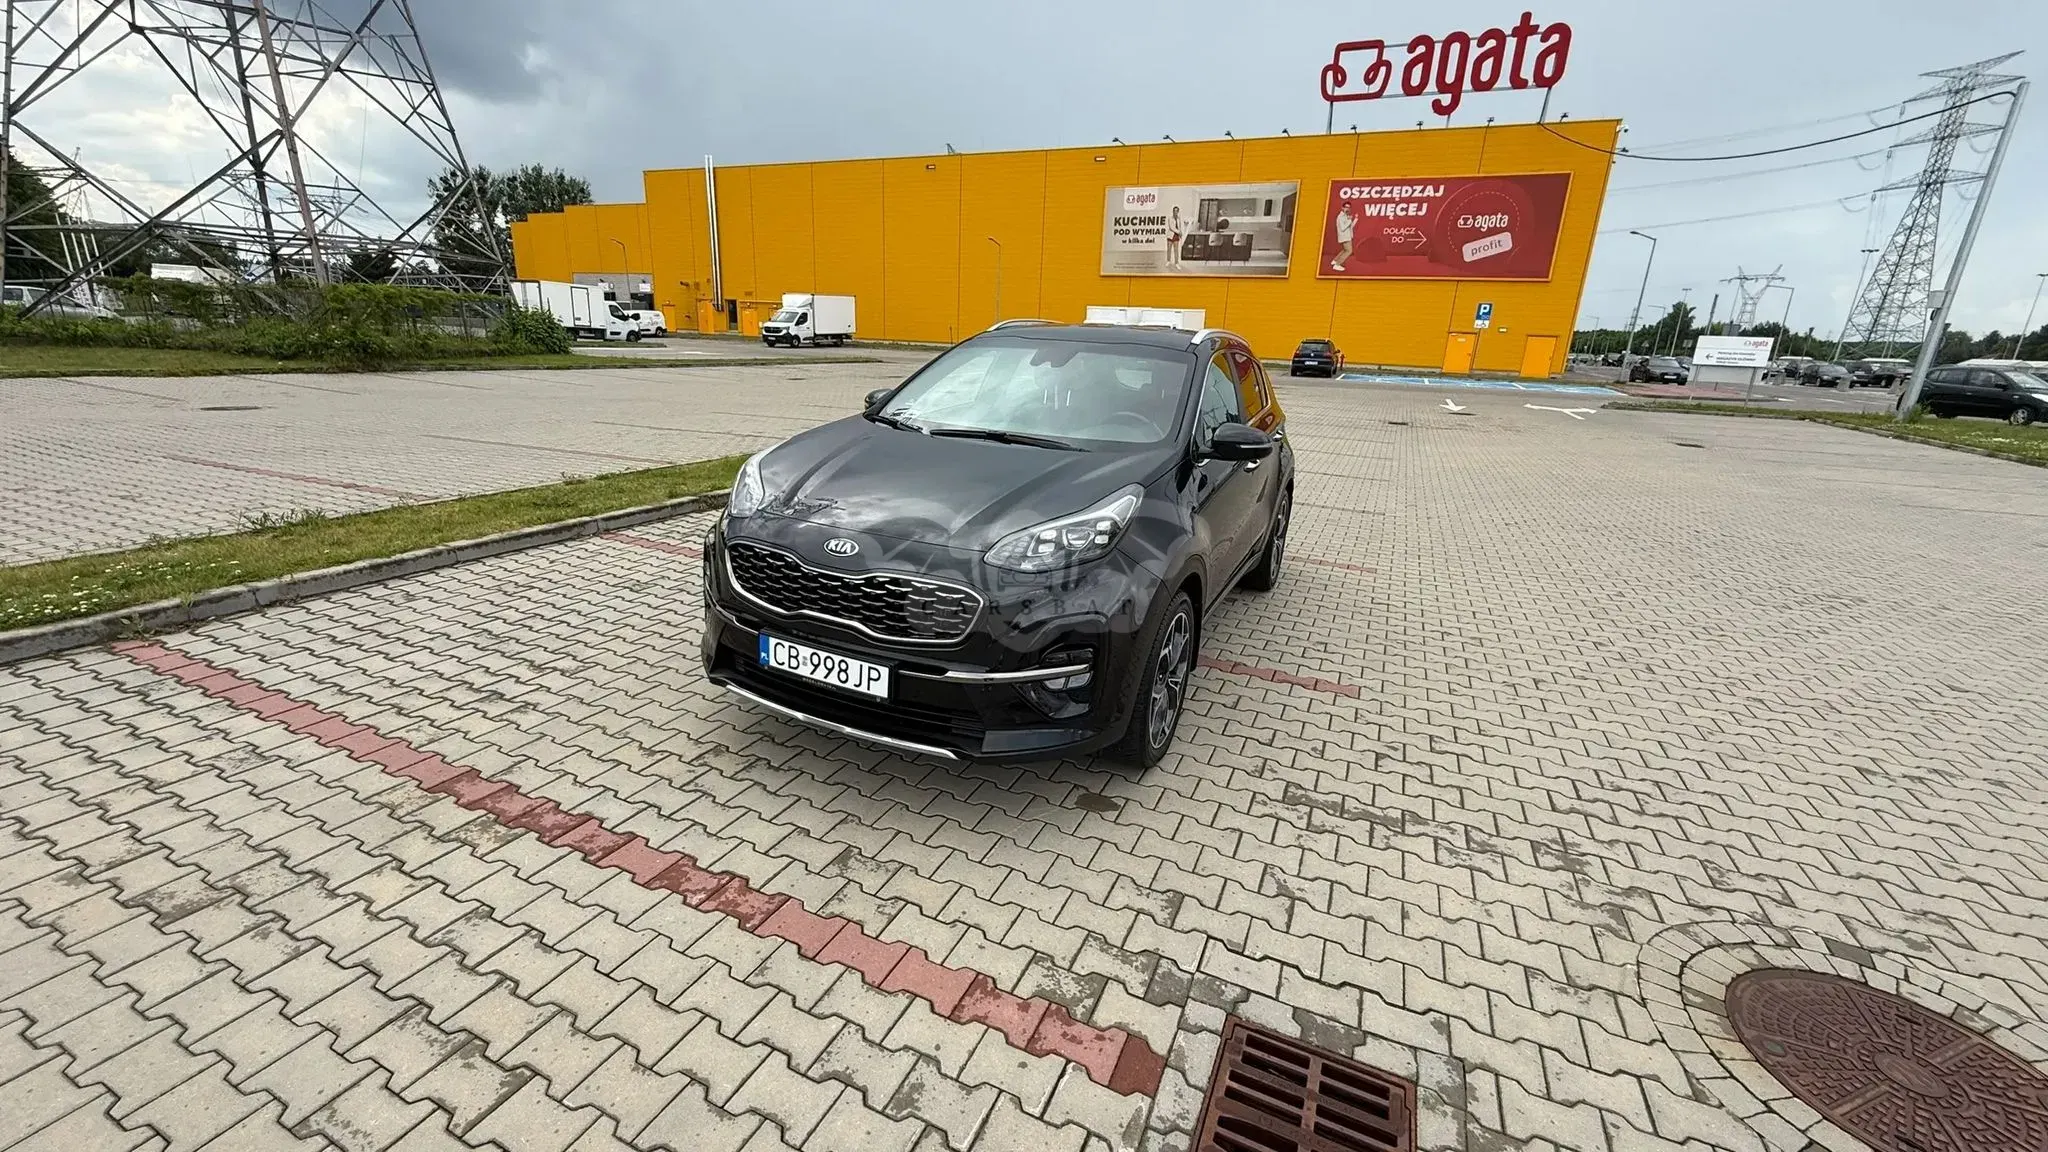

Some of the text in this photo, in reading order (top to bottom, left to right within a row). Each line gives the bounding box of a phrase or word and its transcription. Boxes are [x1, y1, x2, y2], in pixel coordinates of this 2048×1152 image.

[1401, 11, 1572, 116] agata
[1136, 193, 1156, 206] agata
[1339, 185, 1444, 201] OSZCZĘDZAJ
[1364, 203, 1428, 219] WIĘCEJ
[1114, 216, 1166, 226] KUCHNIE
[1474, 212, 1509, 232] agata
[1114, 228, 1131, 236] POD
[1383, 227, 1416, 236] DOŁĄCZ
[1471, 238, 1503, 257] profit
[1480, 304, 1490, 315] P
[828, 540, 852, 554] KIA
[774, 642, 800, 670] CB
